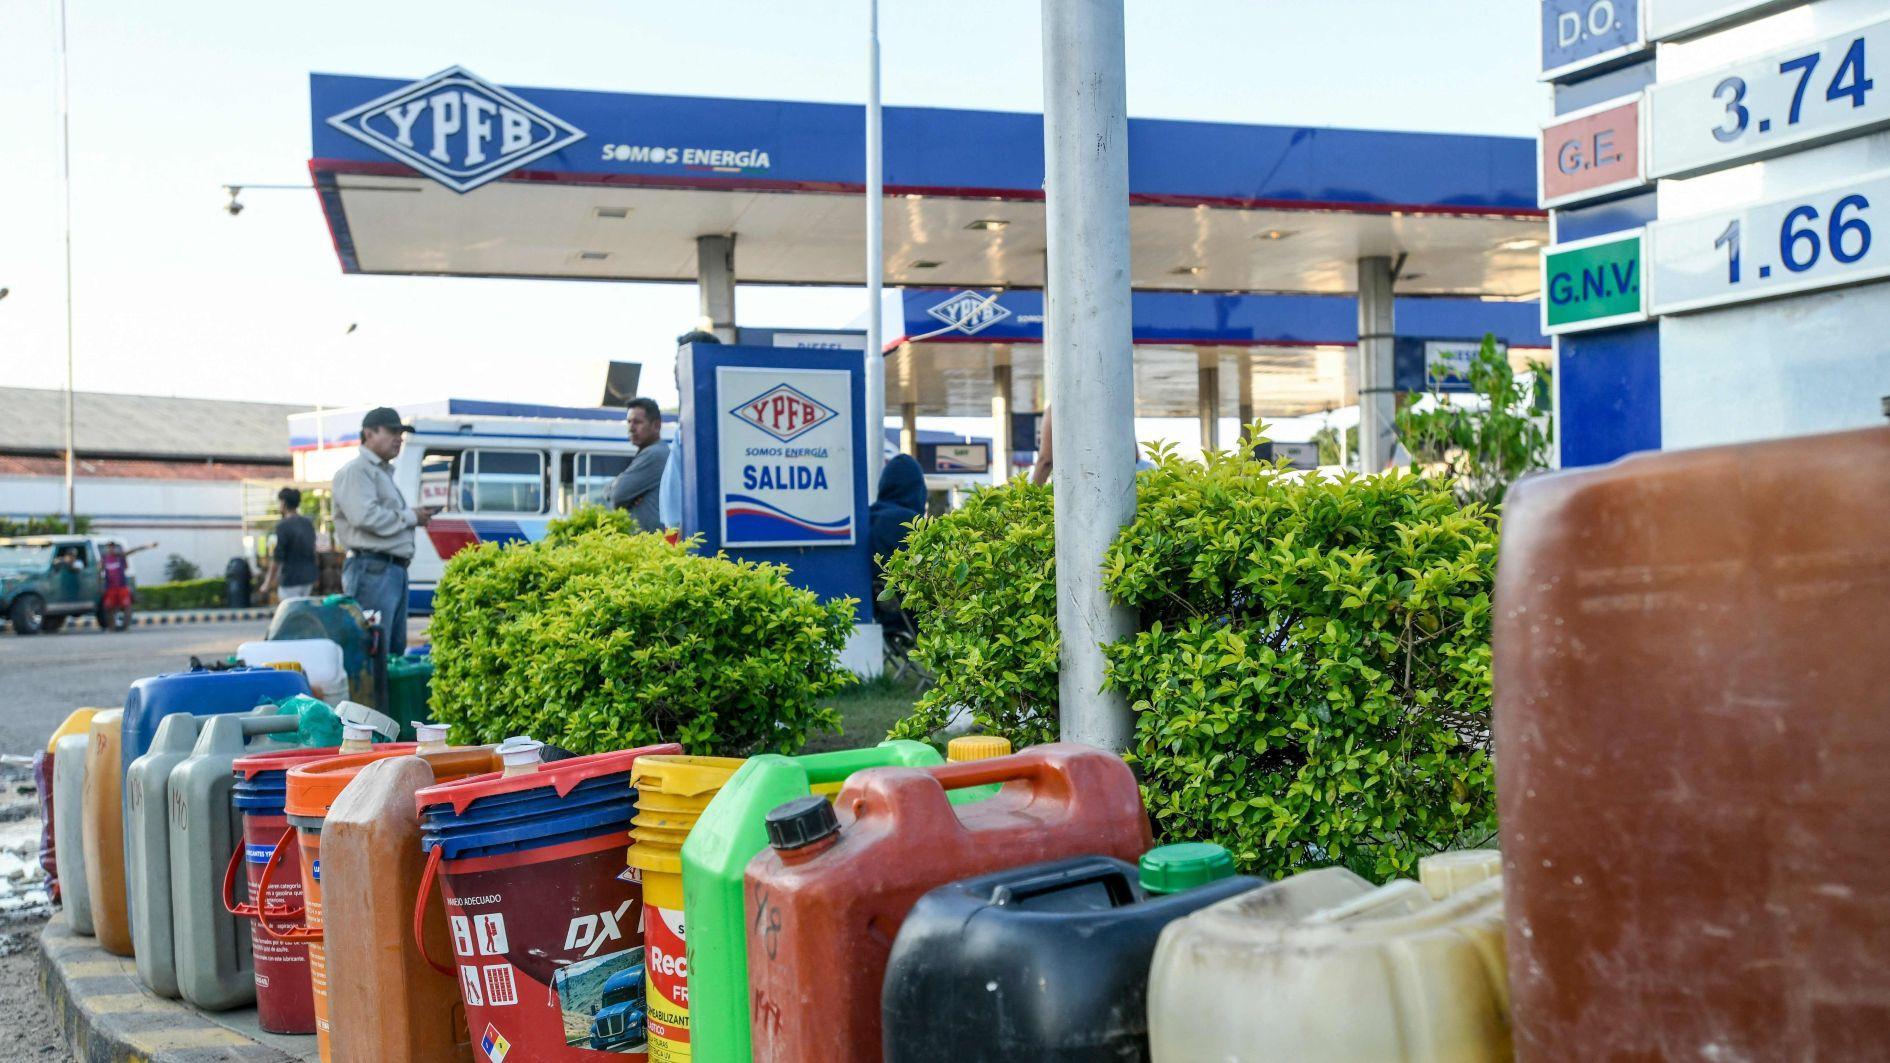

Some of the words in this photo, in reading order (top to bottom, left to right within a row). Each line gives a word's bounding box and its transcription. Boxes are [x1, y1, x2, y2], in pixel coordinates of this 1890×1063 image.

[1558, 0, 1622, 48] D.O.
[1711, 37, 1874, 143] 3.74
[385, 91, 534, 167] YPFB
[1558, 128, 1624, 175] G.E.
[601, 143, 679, 164] SOMOS
[682, 148, 771, 168] ENERGÍA
[1714, 194, 1872, 285] 1.66
[1549, 260, 1639, 306] G.N.V.
[751, 395, 816, 431] YPFB
[745, 448, 782, 456] SOMOS
[785, 446, 829, 458] ENERGÍA
[743, 464, 829, 490] SALIDA
[464, 893, 502, 906] ADECUADO
[563, 898, 634, 957] DX
[651, 945, 688, 978] Rec
